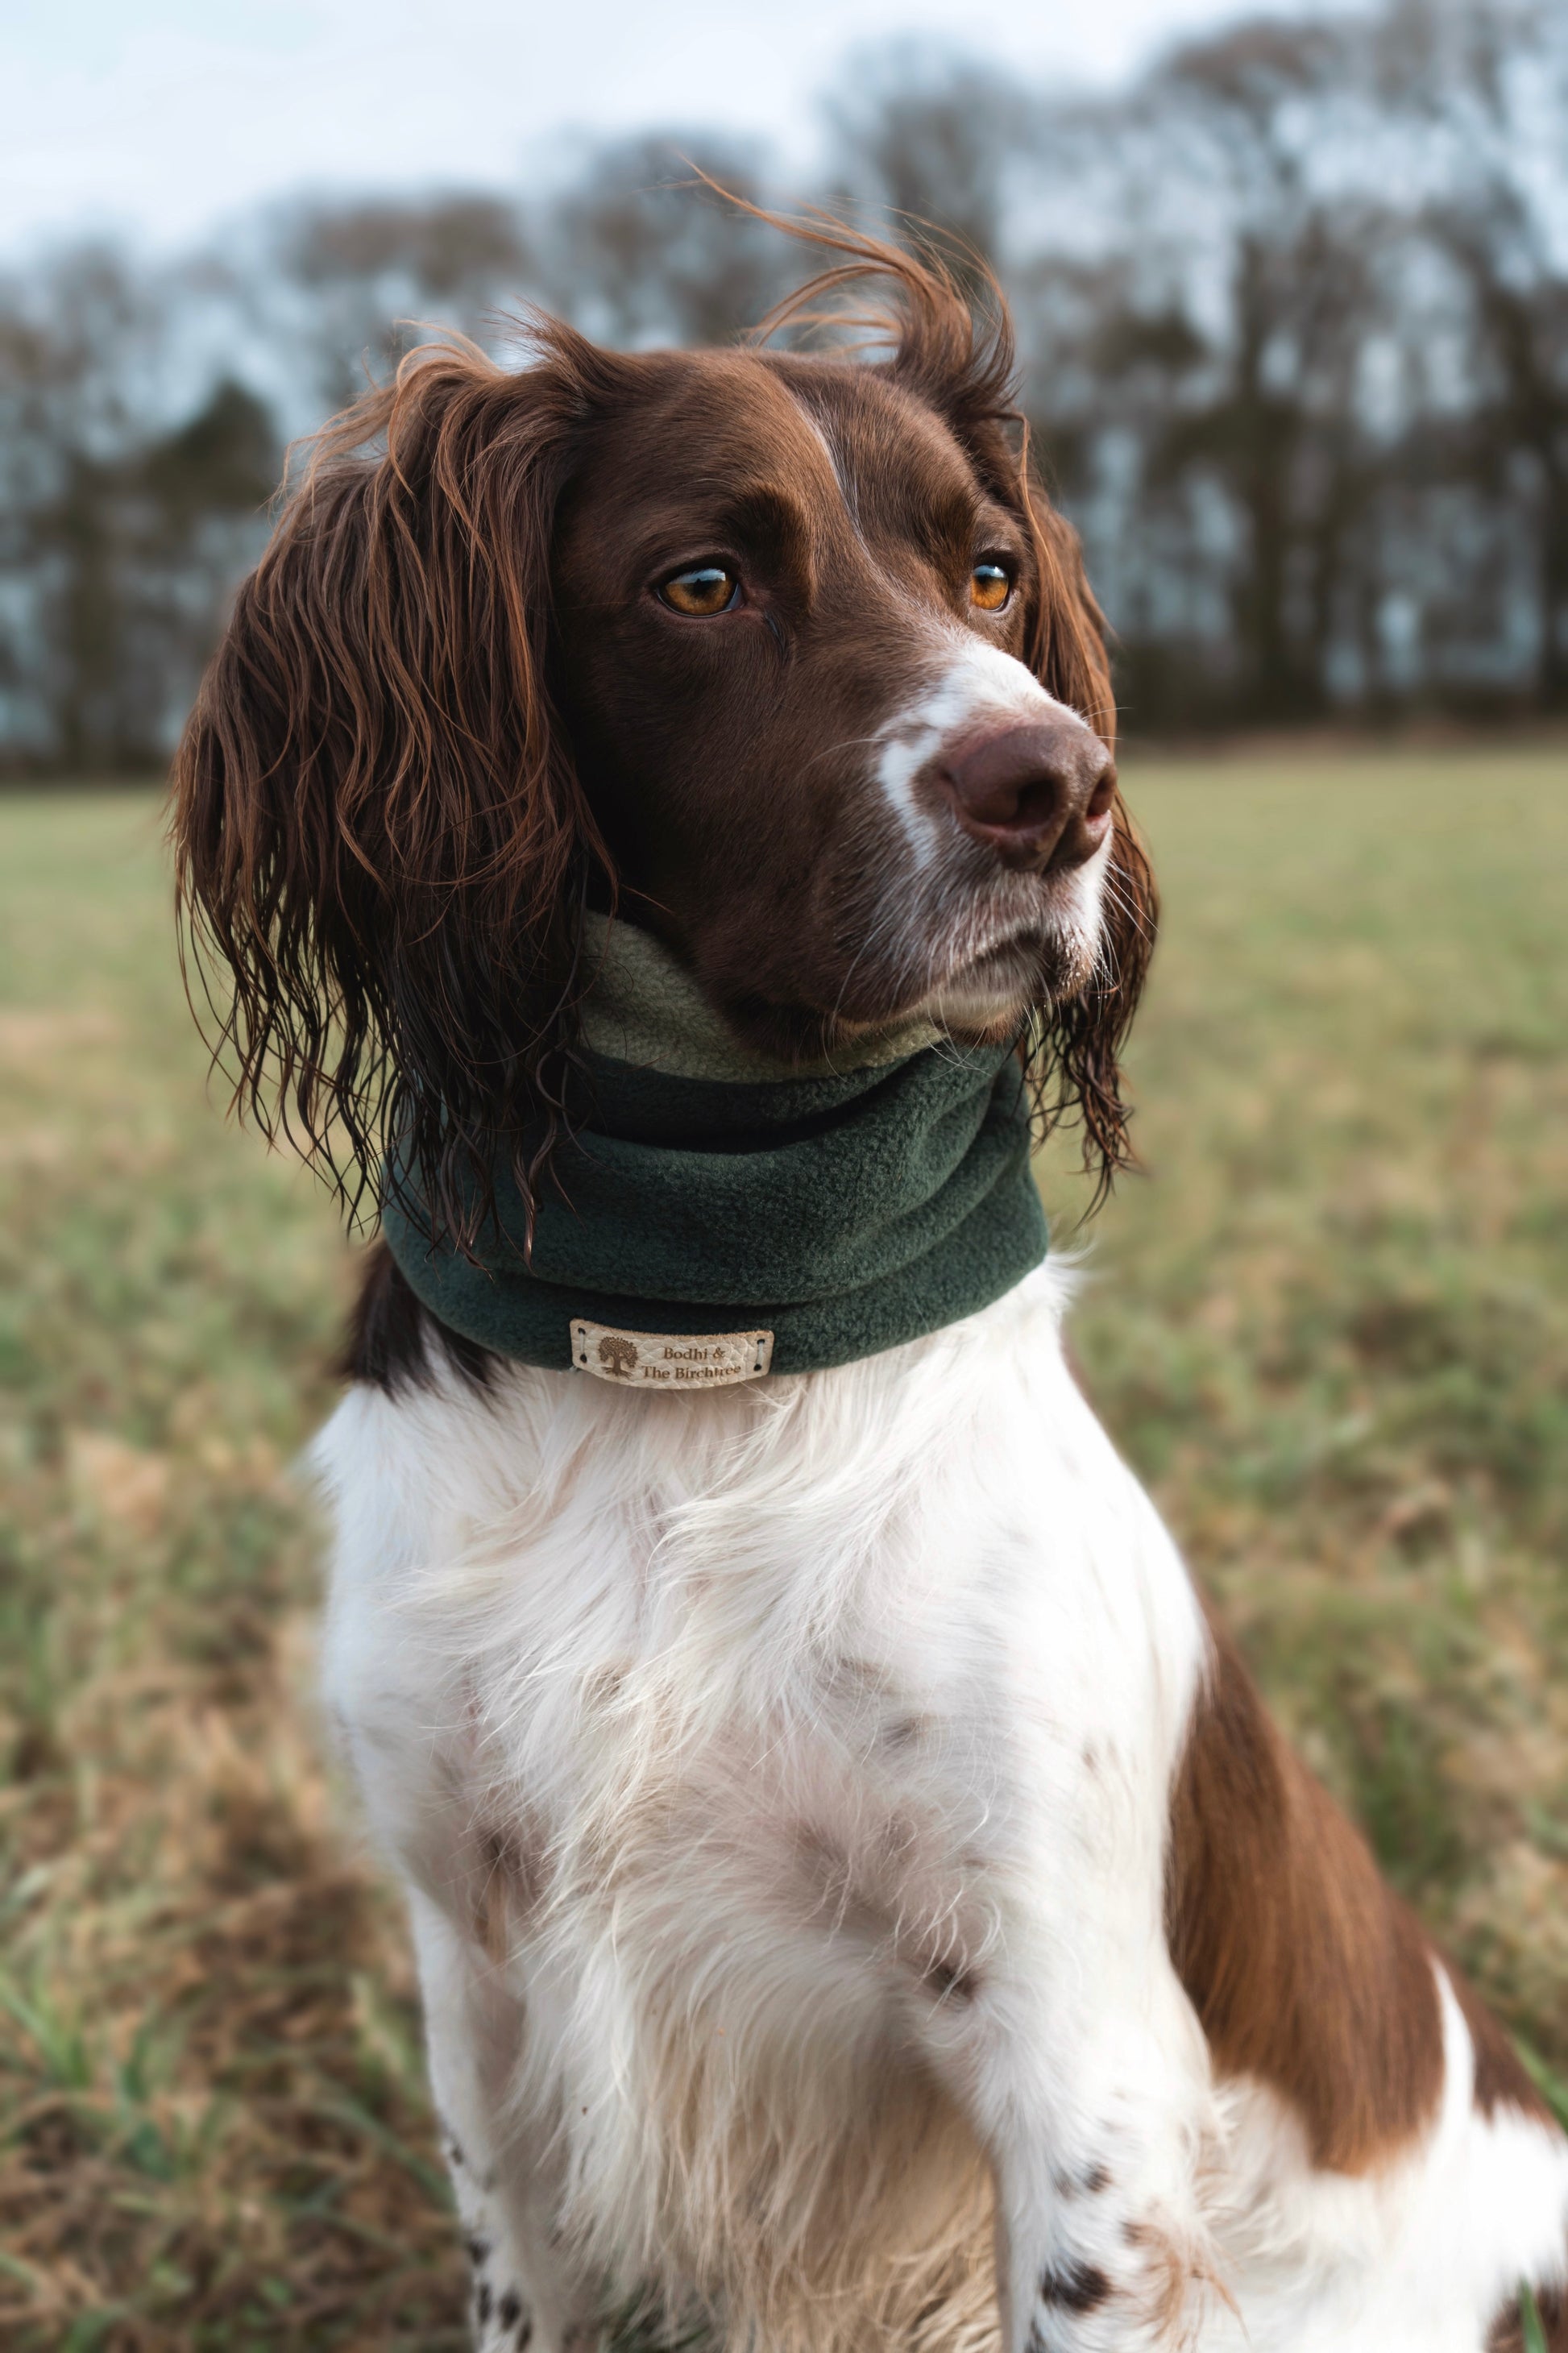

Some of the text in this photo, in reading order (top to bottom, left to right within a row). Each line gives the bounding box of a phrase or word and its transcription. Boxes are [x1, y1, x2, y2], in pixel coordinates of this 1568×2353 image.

[664, 1347, 725, 1360] Bodhi &
[641, 1365, 741, 1379] The Birchtree
